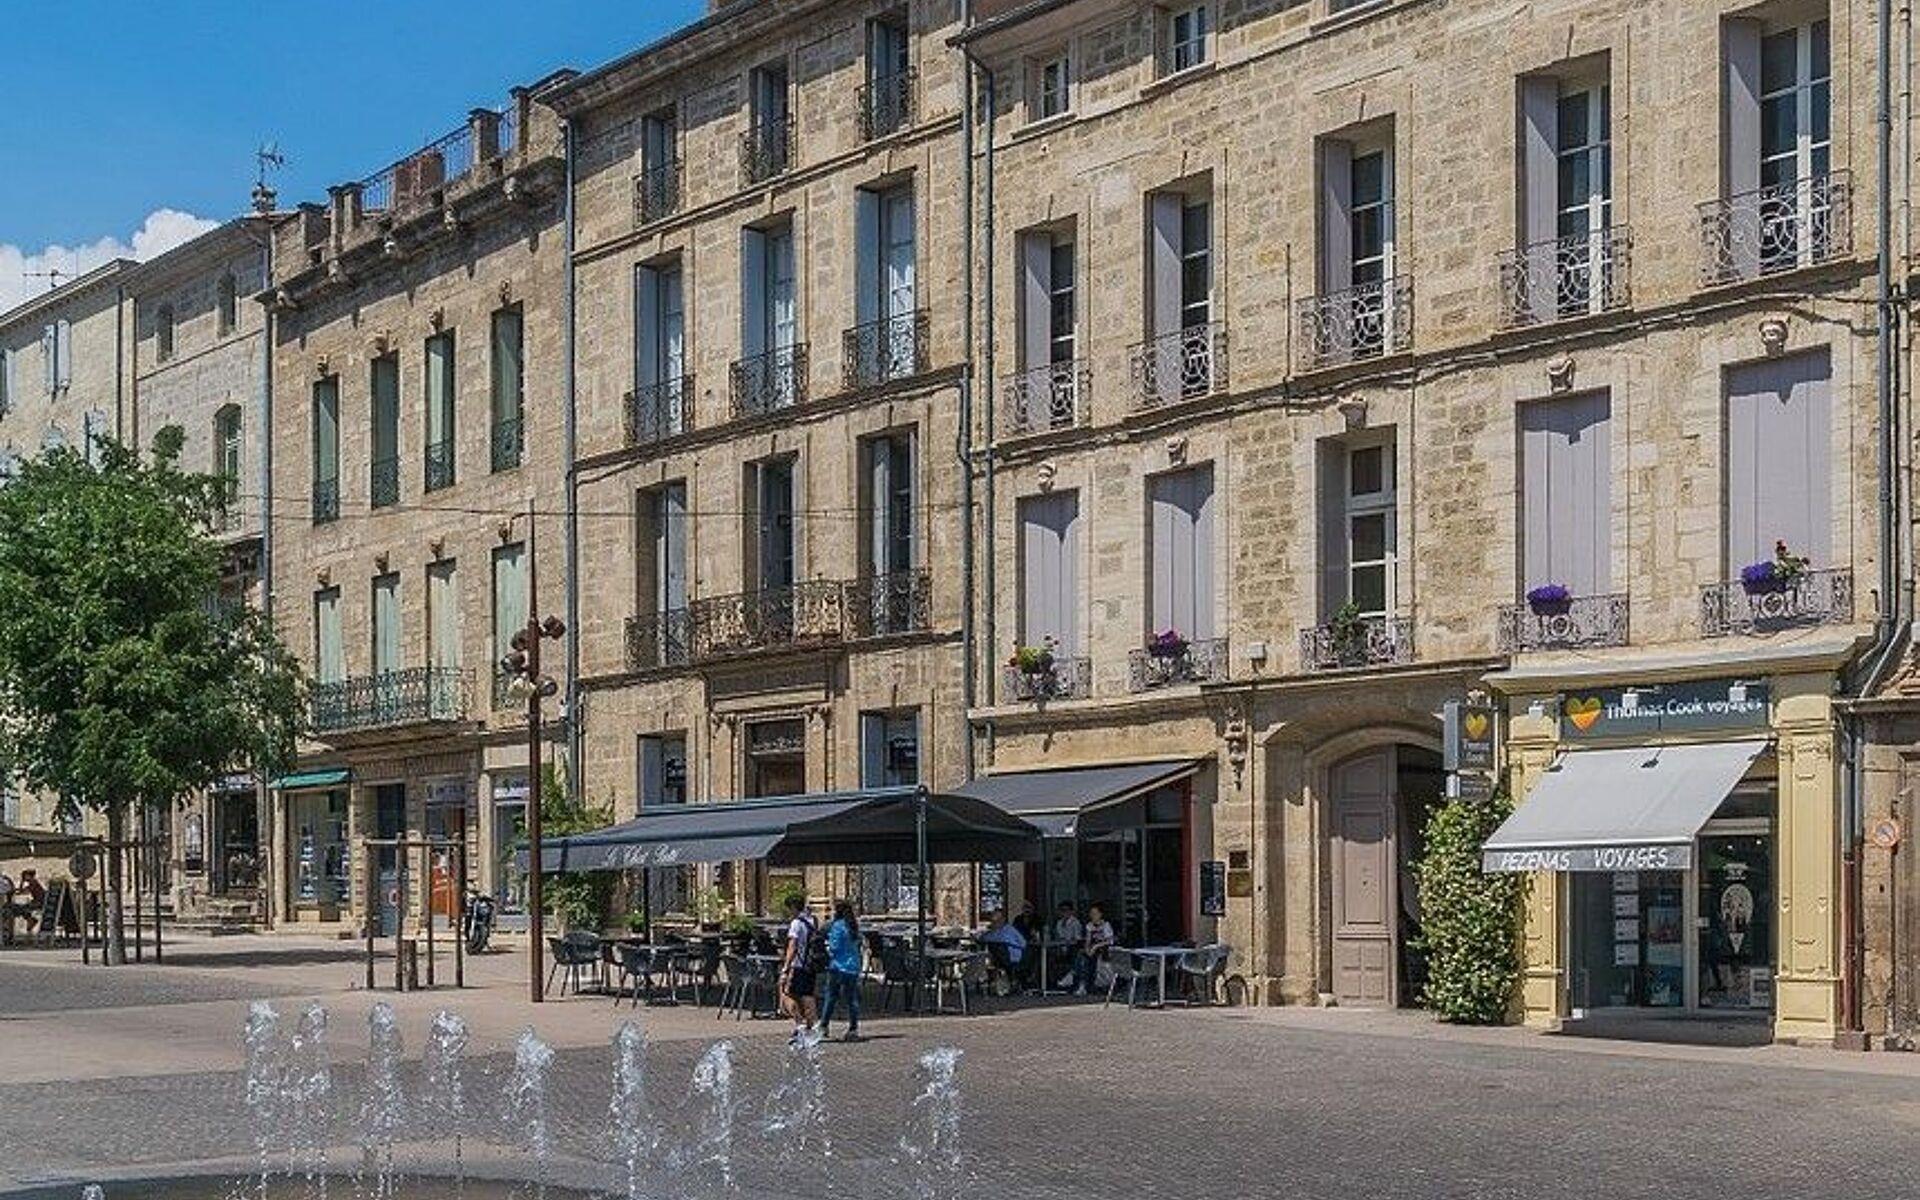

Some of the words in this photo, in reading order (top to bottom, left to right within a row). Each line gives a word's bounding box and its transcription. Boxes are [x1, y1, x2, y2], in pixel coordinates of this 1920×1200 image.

[1606, 703, 1664, 719] Thomas
[1667, 699, 1704, 716] Cook
[1707, 697, 1763, 714] voyages
[1594, 848, 1669, 868] VOYAGES
